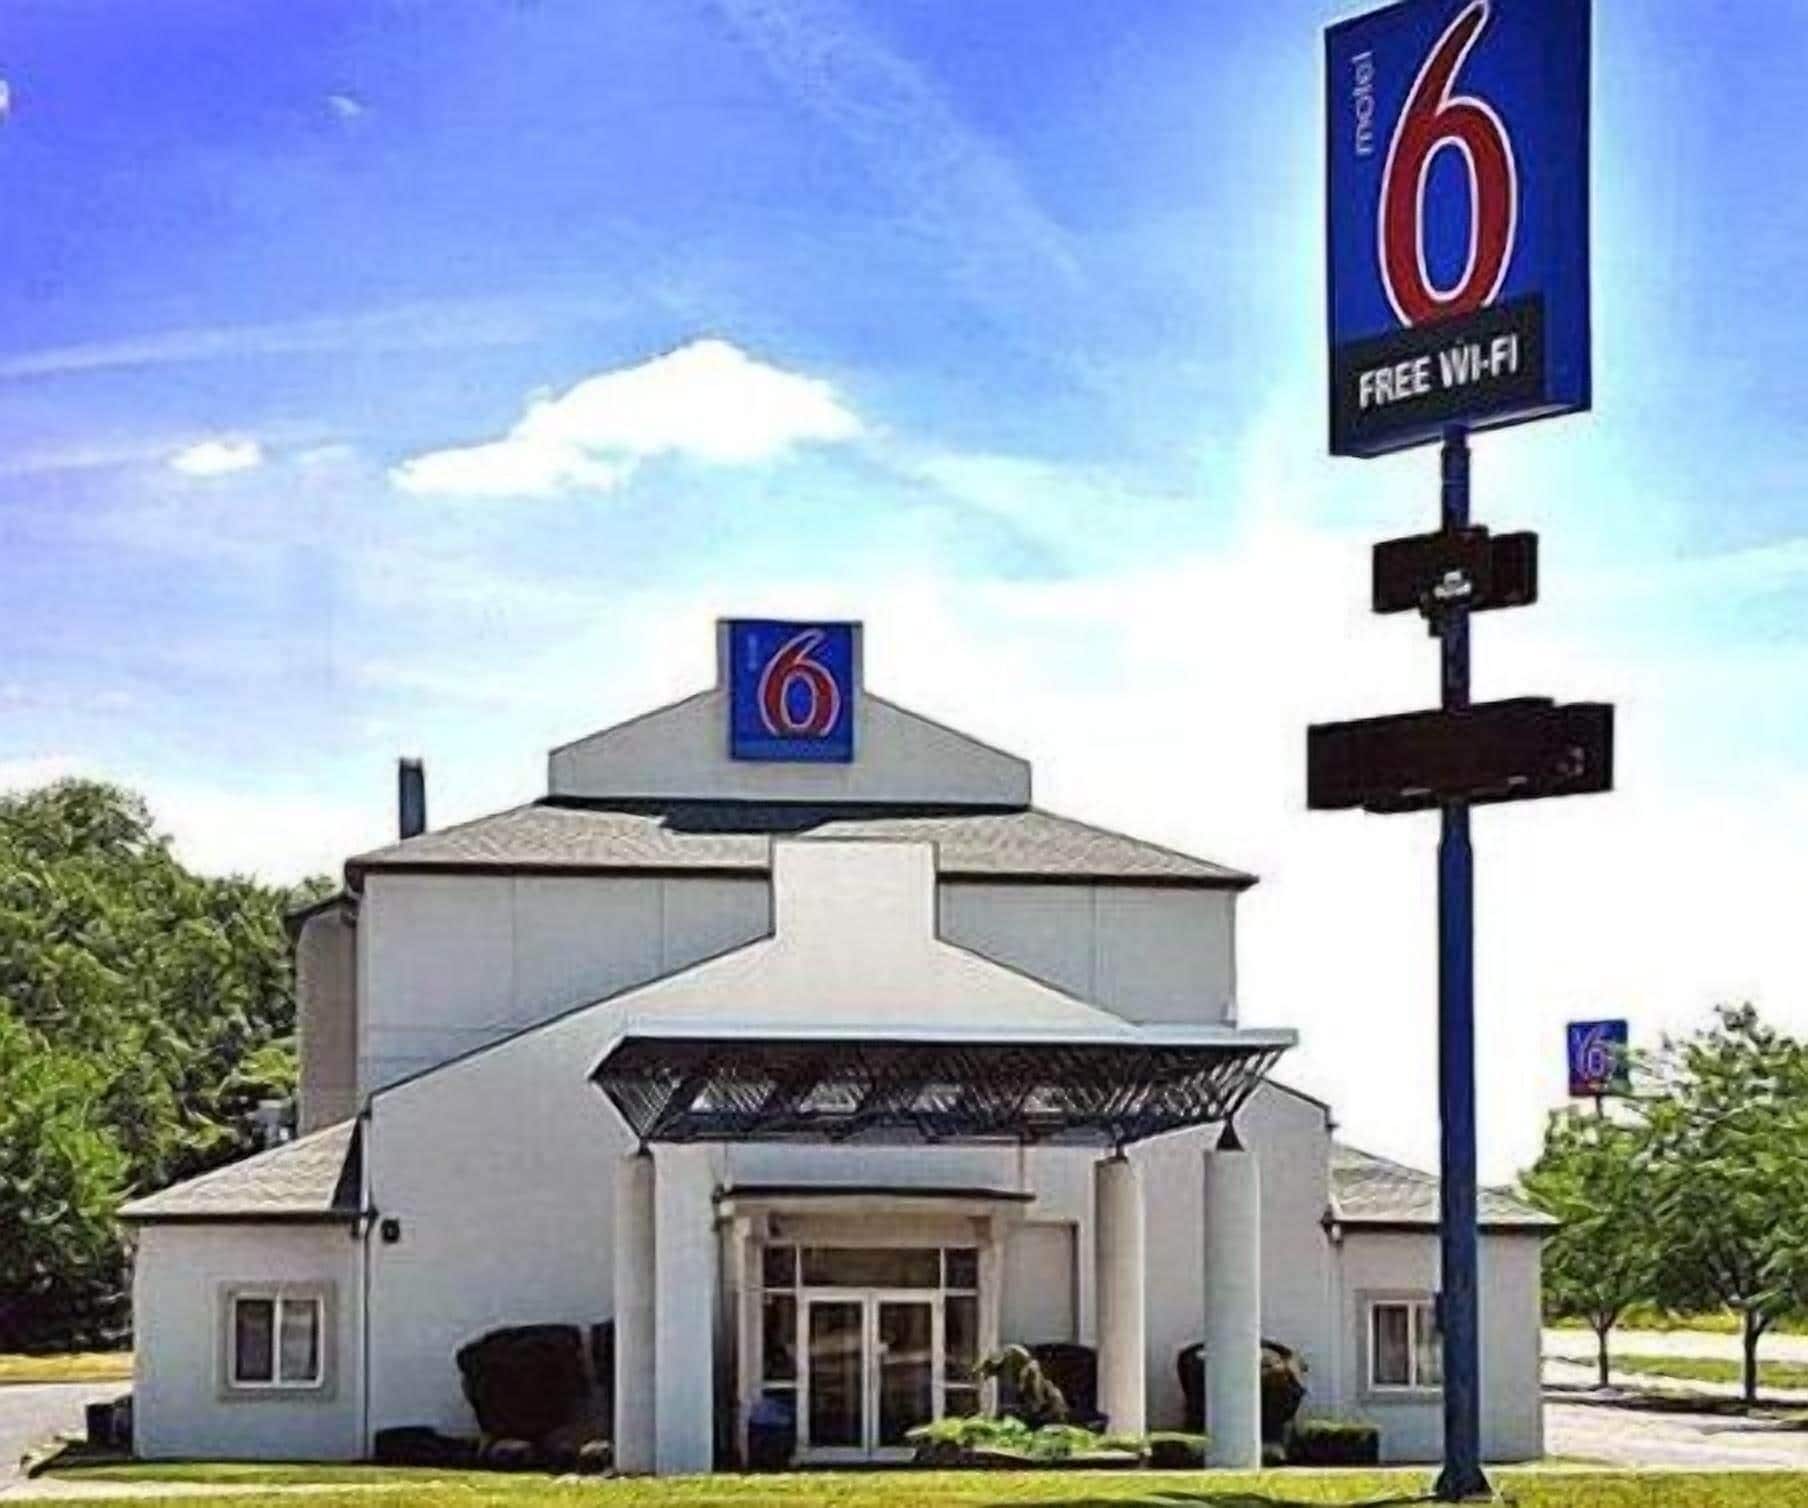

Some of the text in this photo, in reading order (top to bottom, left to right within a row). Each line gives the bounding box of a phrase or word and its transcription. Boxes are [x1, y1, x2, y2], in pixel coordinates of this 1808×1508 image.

[1352, 50, 1375, 155] motel
[1378, 0, 1517, 328] 6
[1359, 334, 1518, 408] FREE WI-FI
[757, 628, 840, 737] 6
[1576, 1025, 1617, 1082] 6
